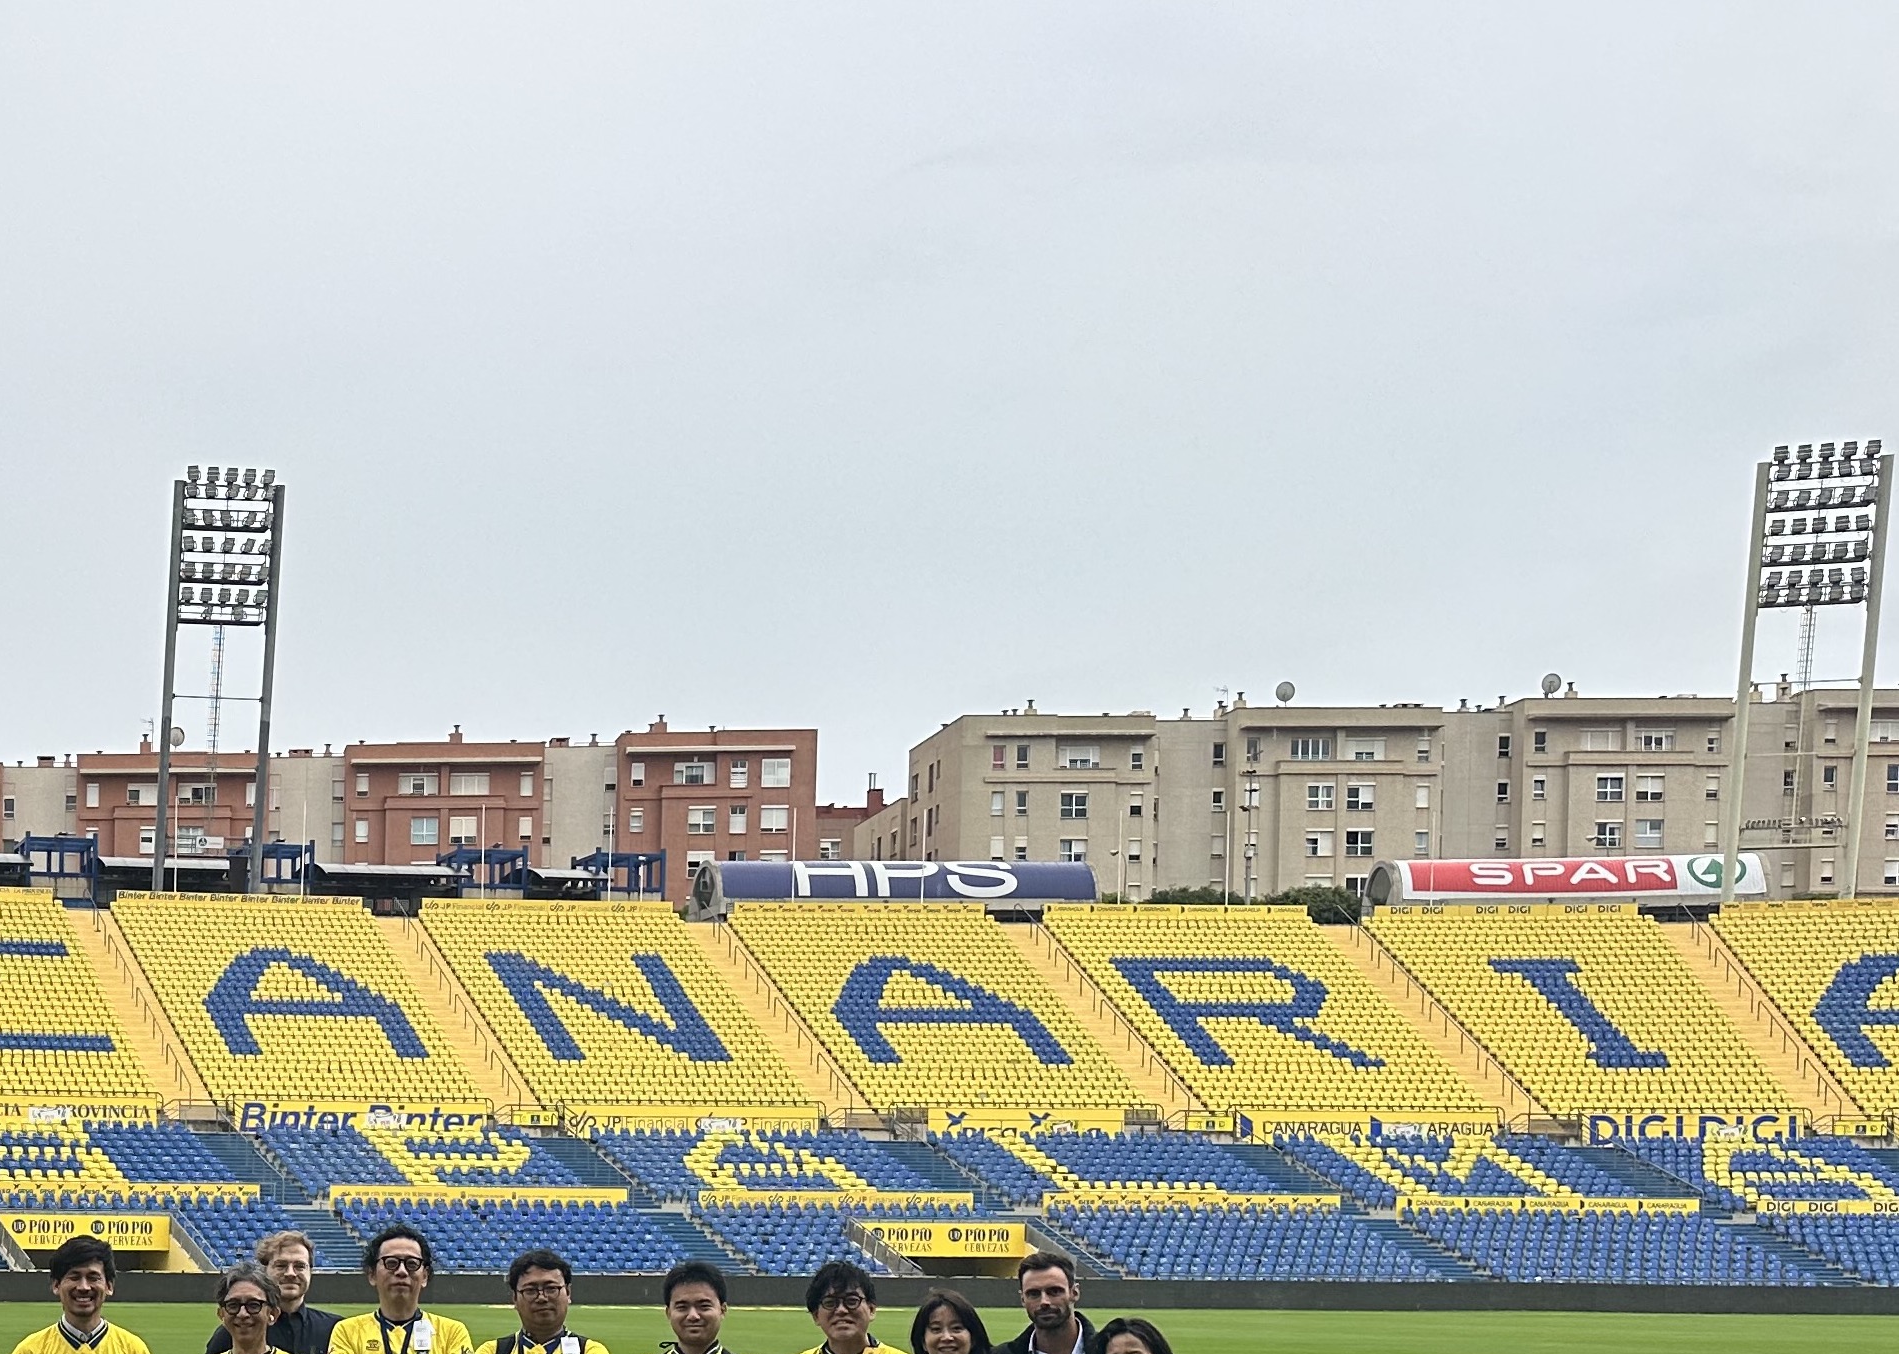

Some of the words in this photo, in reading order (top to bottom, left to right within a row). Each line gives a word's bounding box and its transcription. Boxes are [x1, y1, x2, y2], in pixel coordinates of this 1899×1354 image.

[793, 860, 1019, 898] HPS
[1470, 858, 1674, 888] SPAR
[55, 1104, 151, 1119] ROVINCIA
[240, 1102, 357, 1132] Binter
[1263, 1120, 1363, 1136] CANARAGUA
[1589, 1114, 1684, 1145] DIGI
[1767, 1201, 1795, 1213] DIGI
[1809, 1202, 1838, 1213] DIGI
